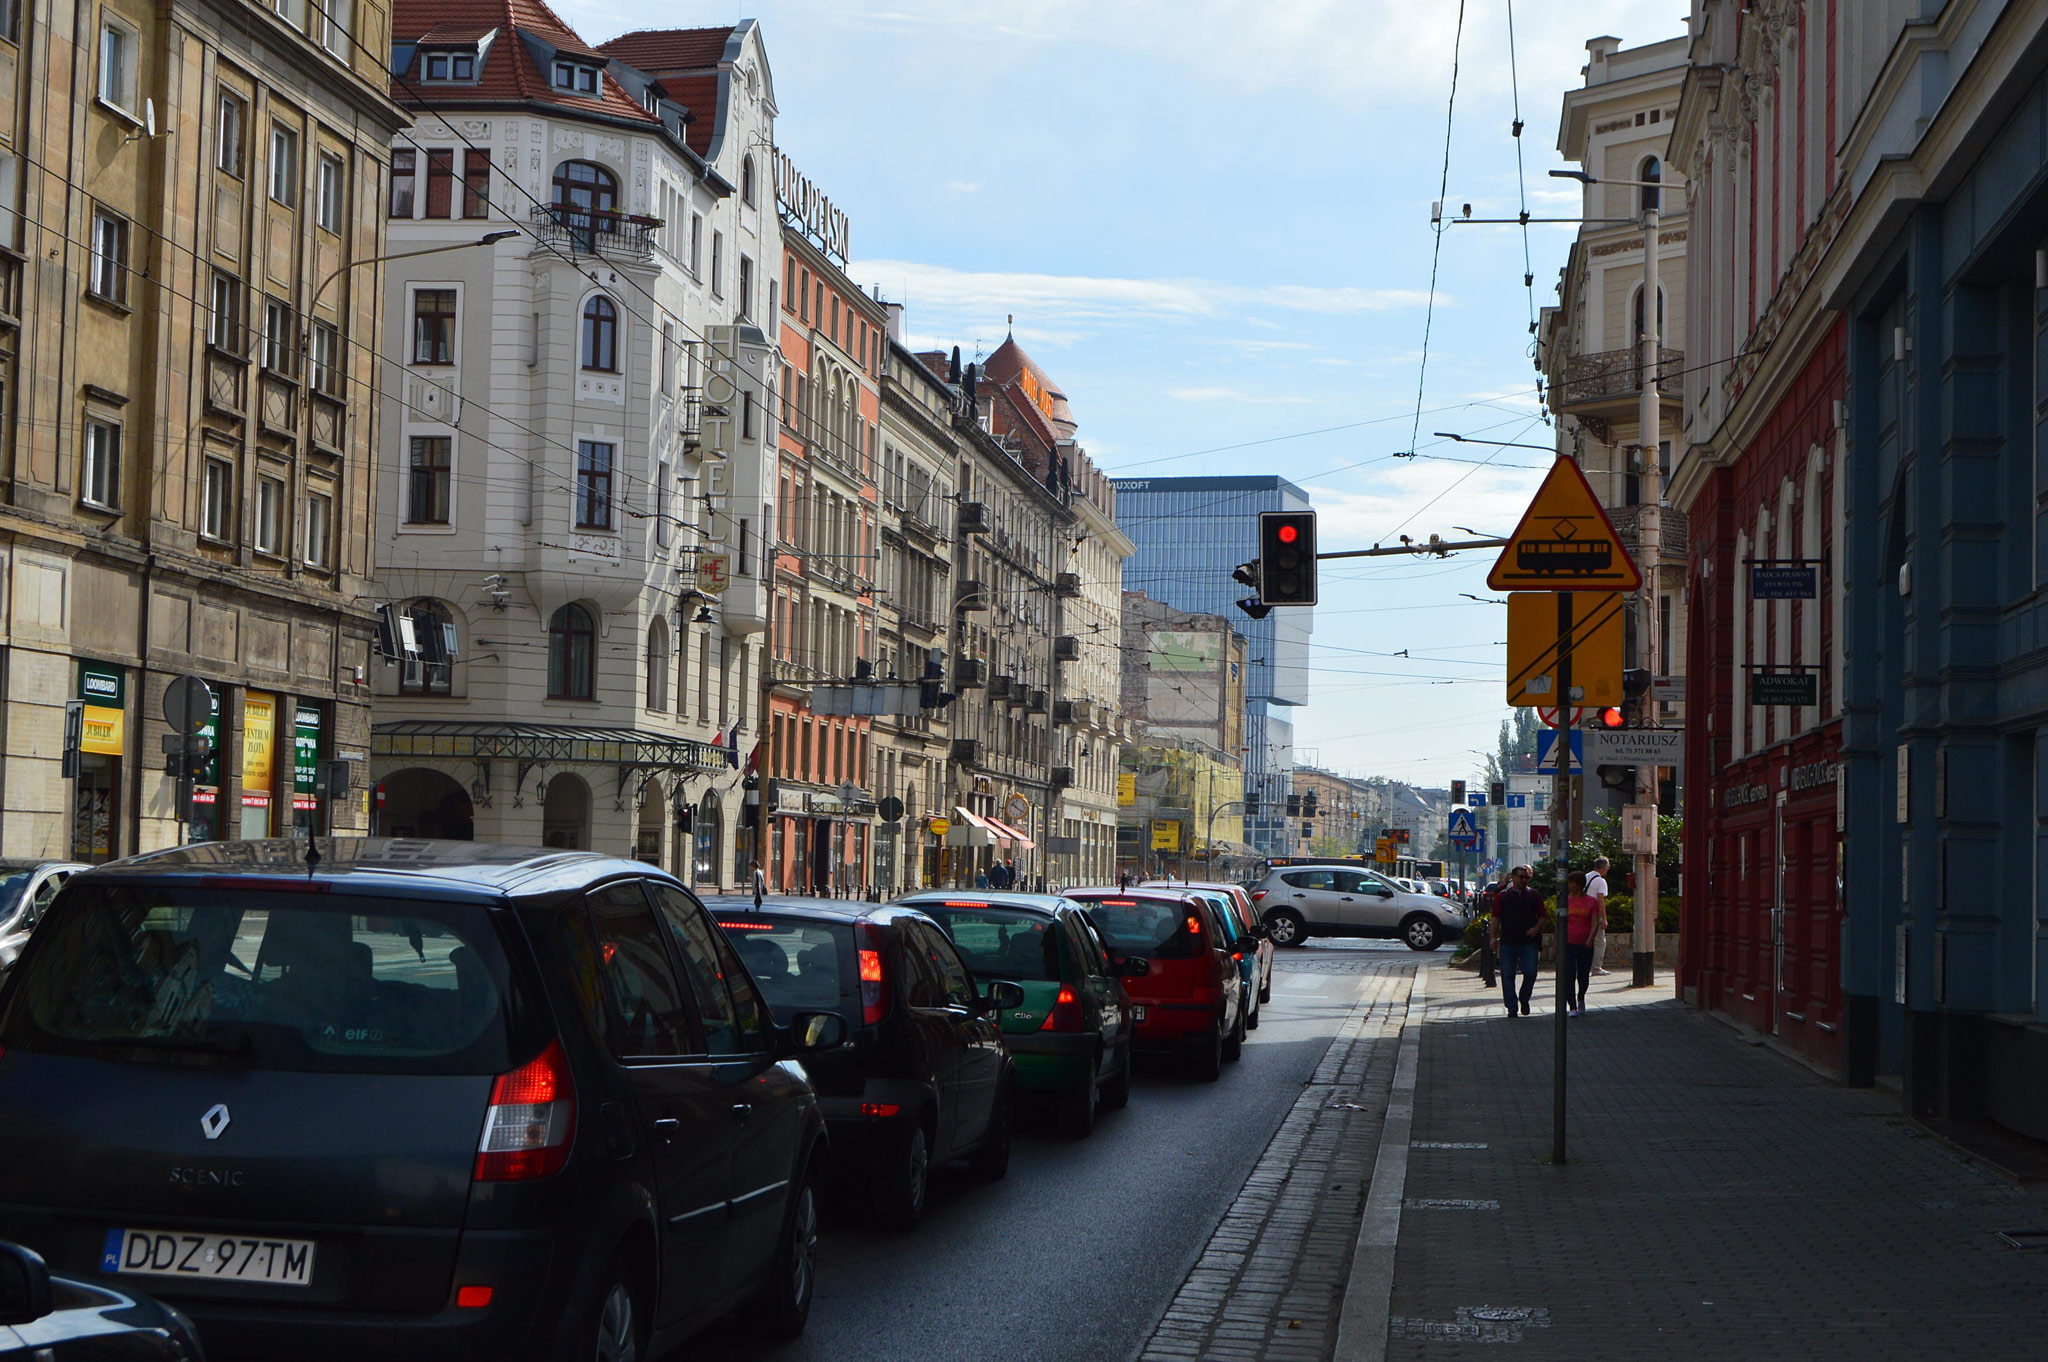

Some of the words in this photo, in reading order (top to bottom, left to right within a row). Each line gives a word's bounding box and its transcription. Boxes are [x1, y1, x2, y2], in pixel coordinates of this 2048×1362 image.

[704, 326, 738, 541] HOTEL
[1116, 481, 1151, 490] UXOFT
[1759, 676, 1810, 686] ADWOKAT
[86, 724, 111, 738] JUBILER
[1599, 734, 1678, 746] NOTARIUSZ
[1014, 1012, 1032, 1020] Clio
[344, 1028, 368, 1041] elf
[169, 1167, 245, 1187] SCENIC
[105, 1254, 118, 1265] PL
[124, 1233, 206, 1273] DDZ
[214, 1240, 310, 1280] 97TM
